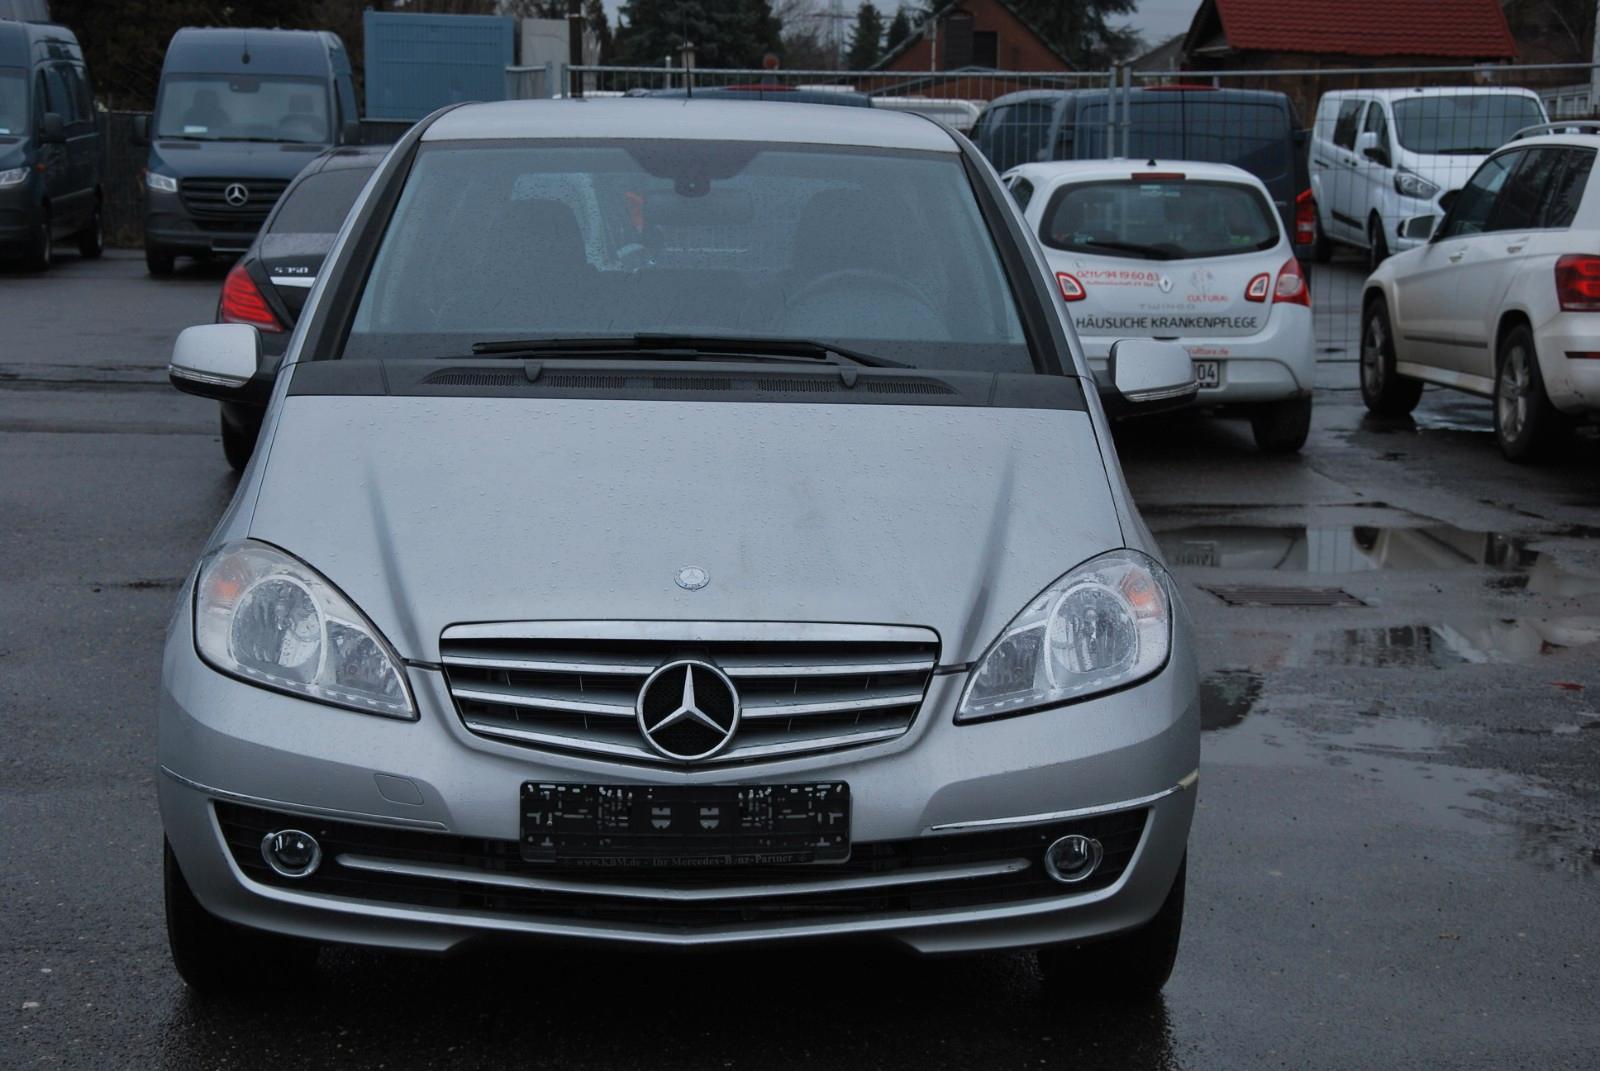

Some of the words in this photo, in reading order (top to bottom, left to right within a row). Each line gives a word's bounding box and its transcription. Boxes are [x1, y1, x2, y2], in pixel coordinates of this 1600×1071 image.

[1131, 271, 1145, 280] 60
[1076, 314, 1147, 329] HÄUSLICHE
[1151, 316, 1258, 329] KRANKENPFLEGE
[1193, 363, 1216, 381] 04
